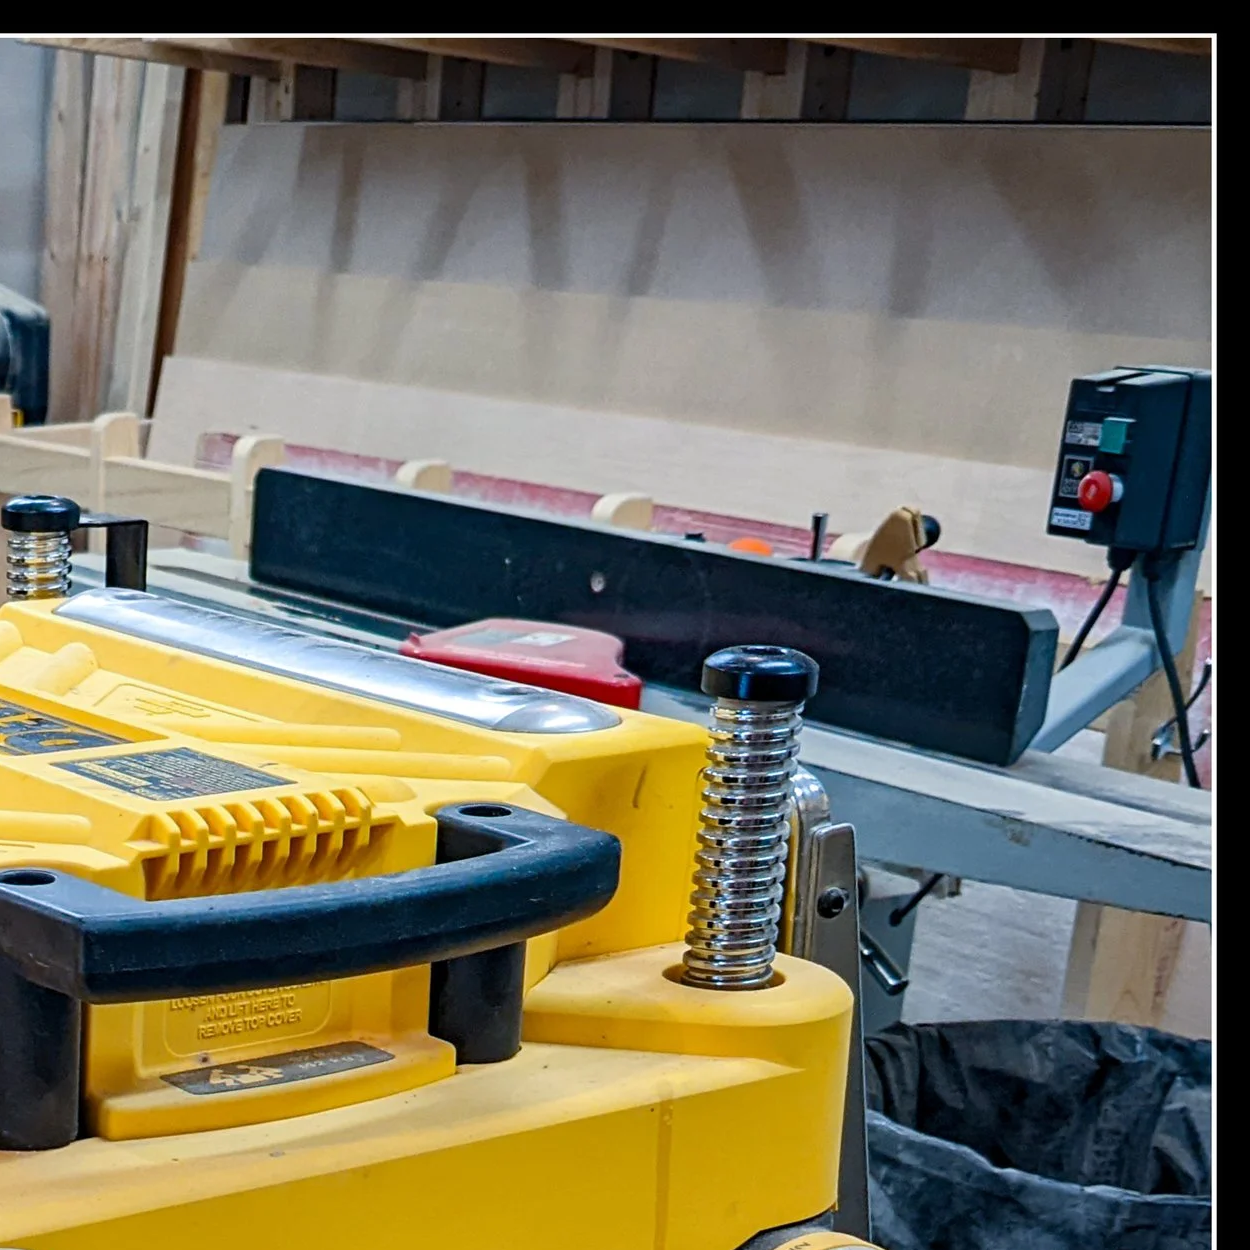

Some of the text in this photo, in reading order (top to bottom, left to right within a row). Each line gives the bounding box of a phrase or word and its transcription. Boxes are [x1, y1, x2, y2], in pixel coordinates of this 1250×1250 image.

[204, 993, 296, 1022] AND LIFT HERE TO
[197, 1008, 303, 1040] REMOVE TOP COVER
